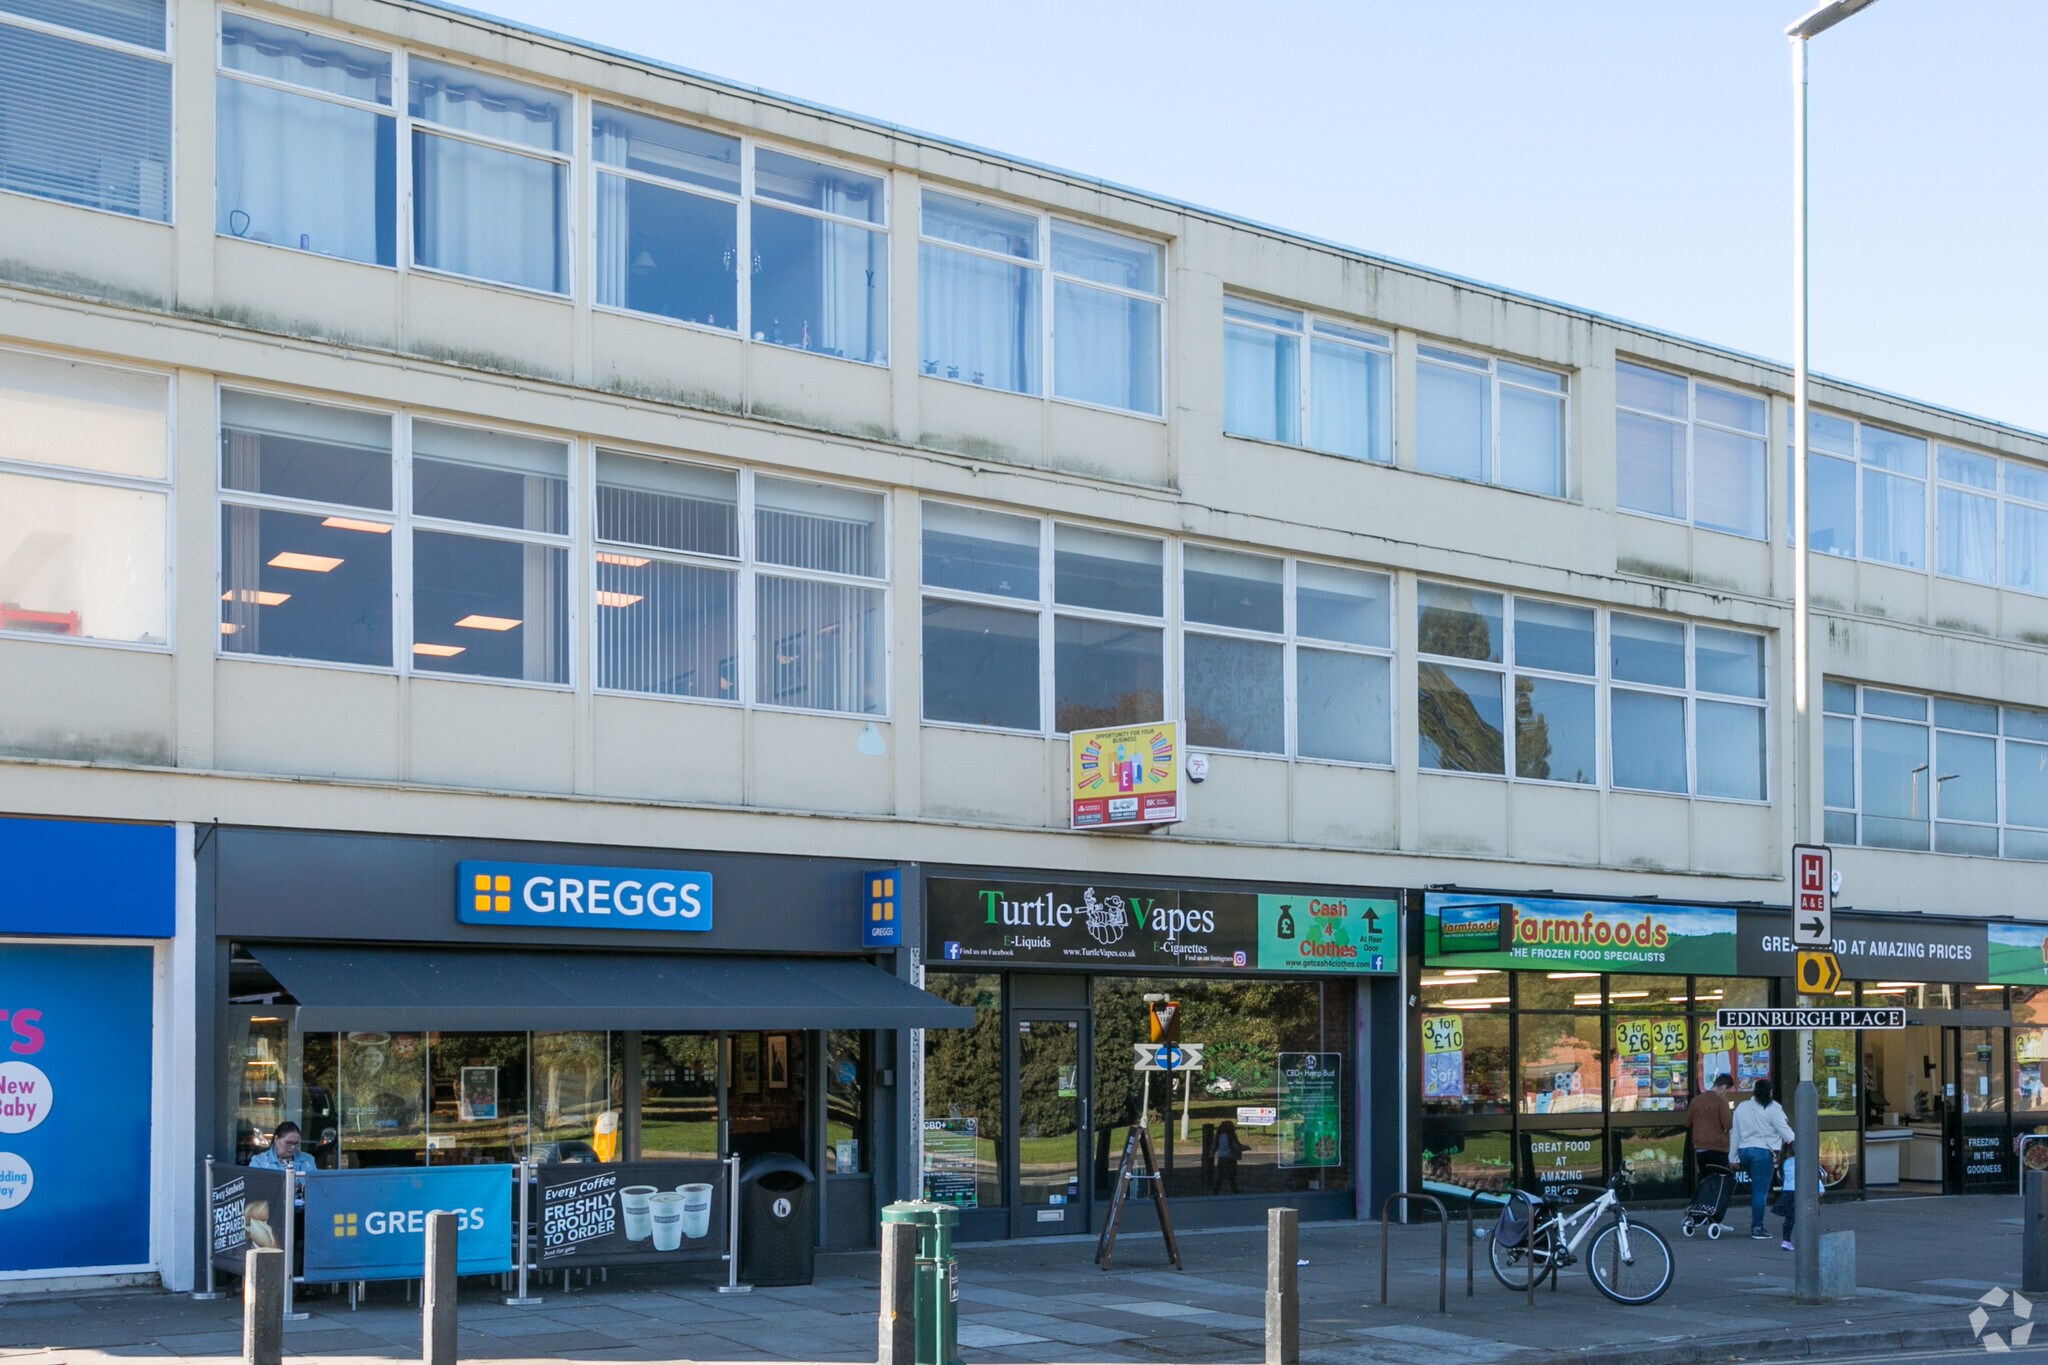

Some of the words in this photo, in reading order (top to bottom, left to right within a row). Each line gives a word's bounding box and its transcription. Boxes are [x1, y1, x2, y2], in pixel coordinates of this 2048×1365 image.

[1096, 731, 1129, 740] OPPORTUNITY
[1804, 859, 1820, 887] H
[523, 876, 701, 918] GREGGS
[978, 890, 1073, 927] Turtle
[1129, 897, 1215, 941] Vapes
[1309, 899, 1347, 918] Cash
[872, 927, 894, 937] GREGGS
[1324, 922, 1332, 936] 4
[1443, 920, 1498, 933] farmfoods
[1004, 935, 1051, 950] E-Liquids
[1360, 935, 1368, 943] At
[960, 947, 972, 955] Find
[988, 948, 1014, 956] Facebook
[1153, 941, 1208, 955] E-Cigarettes
[1299, 940, 1358, 958] Clothes
[1531, 948, 1571, 959] FROZEN
[1574, 950, 1601, 960] FOOD
[1604, 951, 1665, 962] SPECIALISTS
[1762, 936, 1799, 952] GRE
[1851, 940, 1866, 955] AT
[1869, 941, 1925, 958] AMAZING
[1928, 944, 1972, 960] PRICES
[1285, 959, 1370, 968] www.getcash4clothes.com
[1726, 1011, 1834, 1026] EDINBURGH
[1840, 1011, 1900, 1026] PLACE
[1423, 1019, 1435, 1039] 3
[1439, 1017, 1456, 1029] for
[1617, 1024, 1628, 1042] 3
[1631, 1022, 1646, 1033] for
[1653, 1024, 1664, 1042] 3
[1666, 1022, 1681, 1033] for
[1701, 1022, 1710, 1040] 2
[1434, 1031, 1462, 1049] £10
[1629, 1032, 1651, 1053] £6
[1664, 1032, 1685, 1053] £5
[1746, 1032, 1769, 1049] £10
[1304, 1070, 1322, 1079] Hemp
[1322, 1069, 1335, 1077] Bud
[0, 1096, 37, 1121] aby
[1531, 1142, 1562, 1153] GREAT
[1565, 1141, 1591, 1152] FOOD
[1968, 1137, 2000, 1146] FREEZING
[1555, 1156, 1567, 1167] AT
[1973, 1152, 1981, 1160] IN
[1981, 1151, 1995, 1160] THE
[1540, 1170, 1582, 1182] AMAZING
[1967, 1164, 2002, 1175] GOODNESS
[0, 1187, 15, 1199] ay
[545, 1185, 577, 1201] Every
[579, 1176, 617, 1193] Coffee
[544, 1192, 617, 1222] FRESHLY
[214, 1216, 246, 1237] REPARED
[544, 1207, 616, 1235] GROUND
[544, 1233, 564, 1247] TO
[567, 1220, 615, 1244] ORDER
